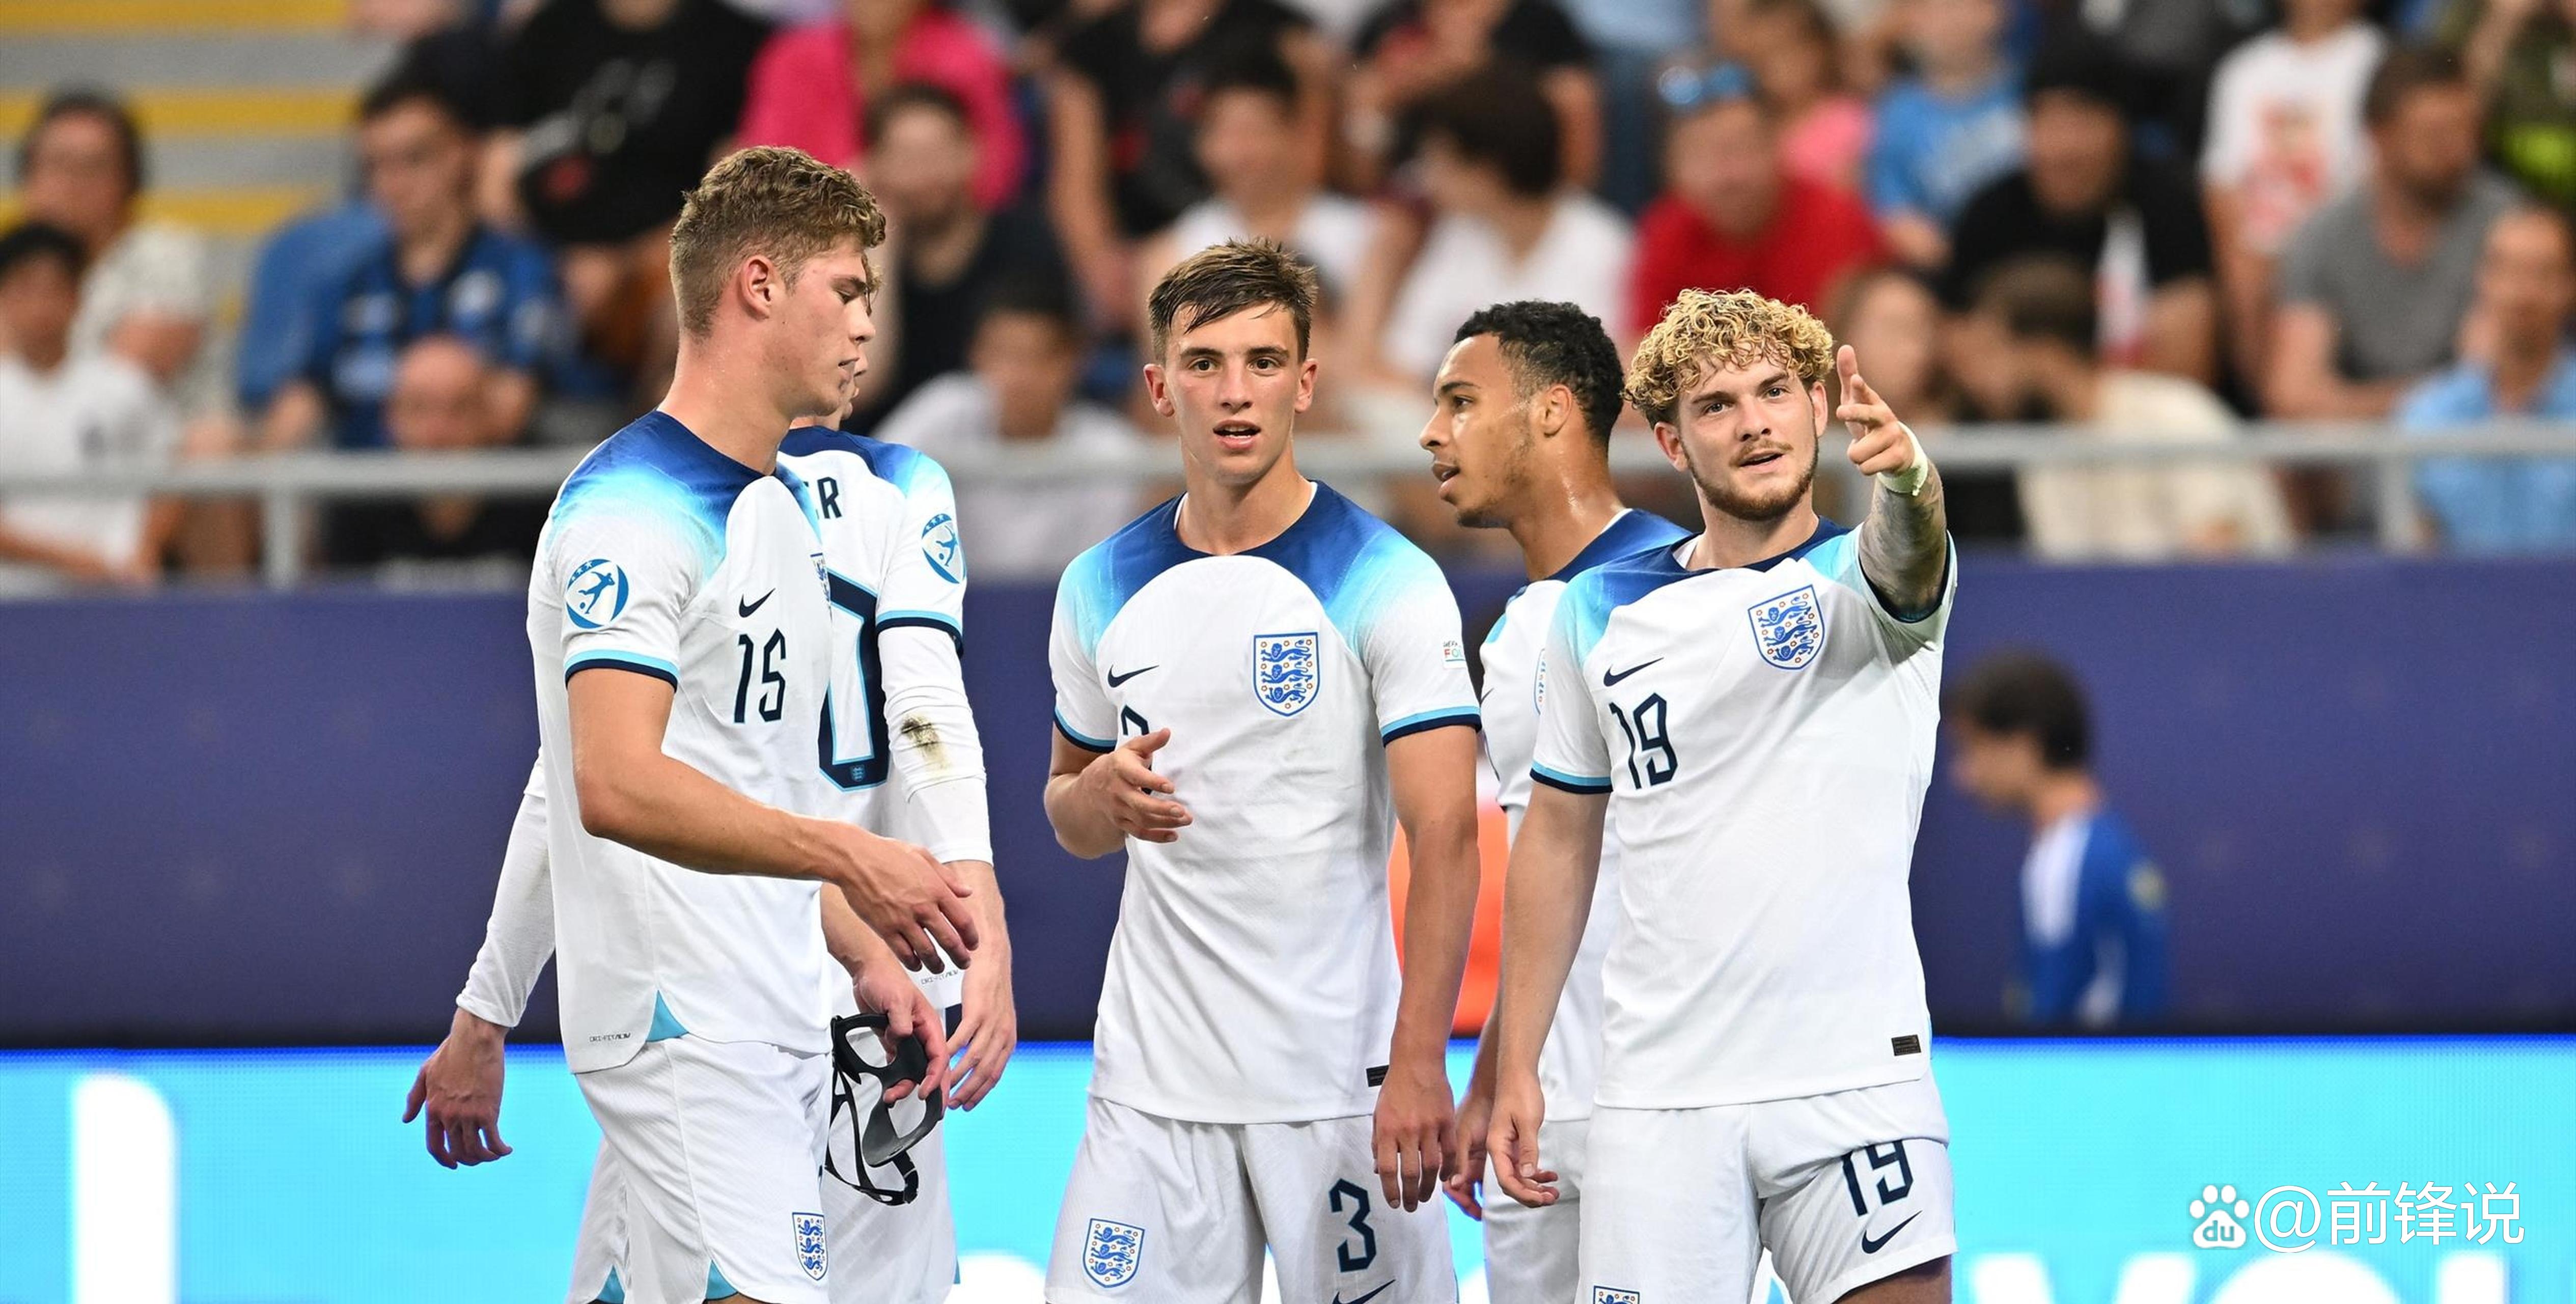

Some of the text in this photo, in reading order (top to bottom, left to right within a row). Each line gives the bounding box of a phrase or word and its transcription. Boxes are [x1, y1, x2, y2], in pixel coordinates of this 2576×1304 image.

[733, 628, 786, 724] 15
[1609, 692, 1678, 789] 19
[1329, 1178, 1376, 1272] 3
[1842, 1140, 1914, 1216] 19
